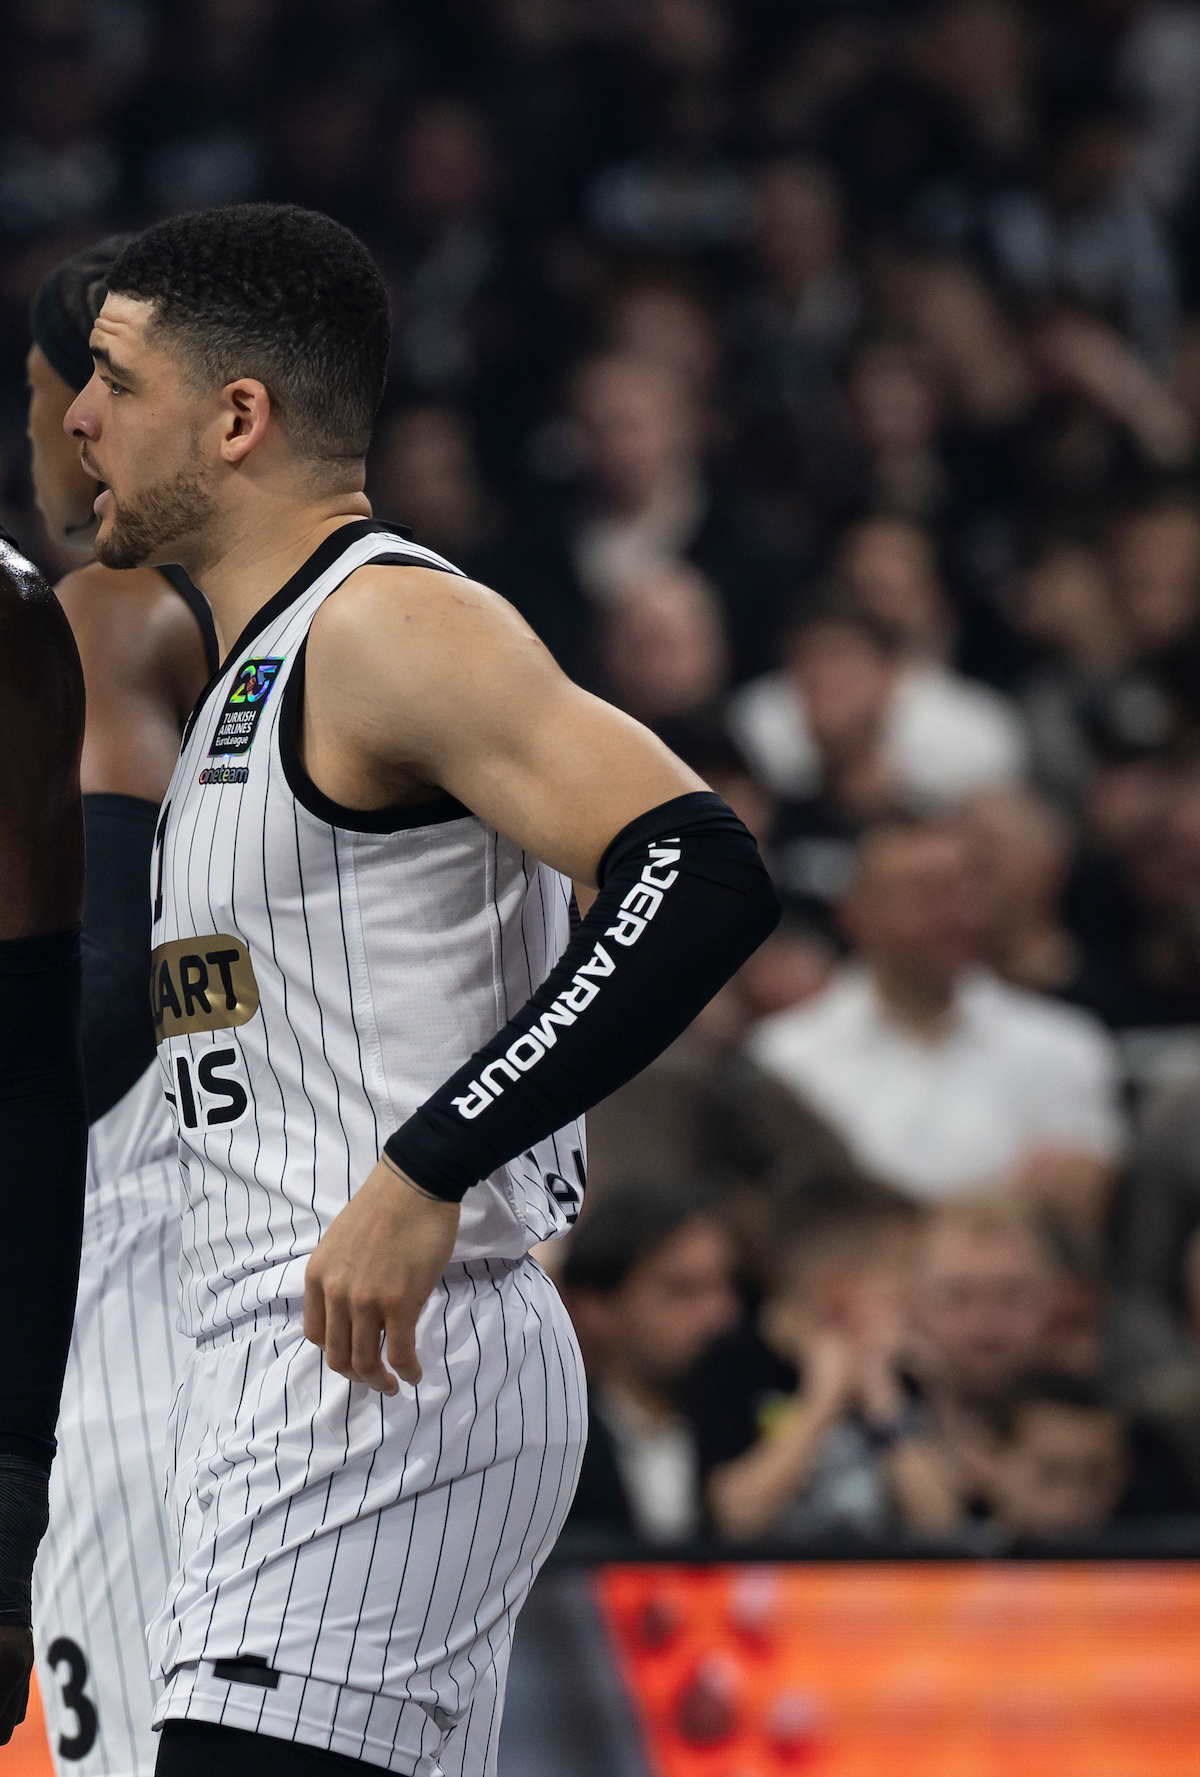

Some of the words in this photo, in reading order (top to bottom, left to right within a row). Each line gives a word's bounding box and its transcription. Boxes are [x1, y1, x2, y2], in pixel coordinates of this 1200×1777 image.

[229, 665, 278, 704] 25
[223, 710, 256, 724] TURKISH
[218, 722, 253, 736] AIRLINES
[215, 735, 249, 747] EuroLeague
[199, 765, 249, 785] oneteam
[451, 941, 616, 1119] ARMOUR
[47, 1636, 98, 1760] 3
